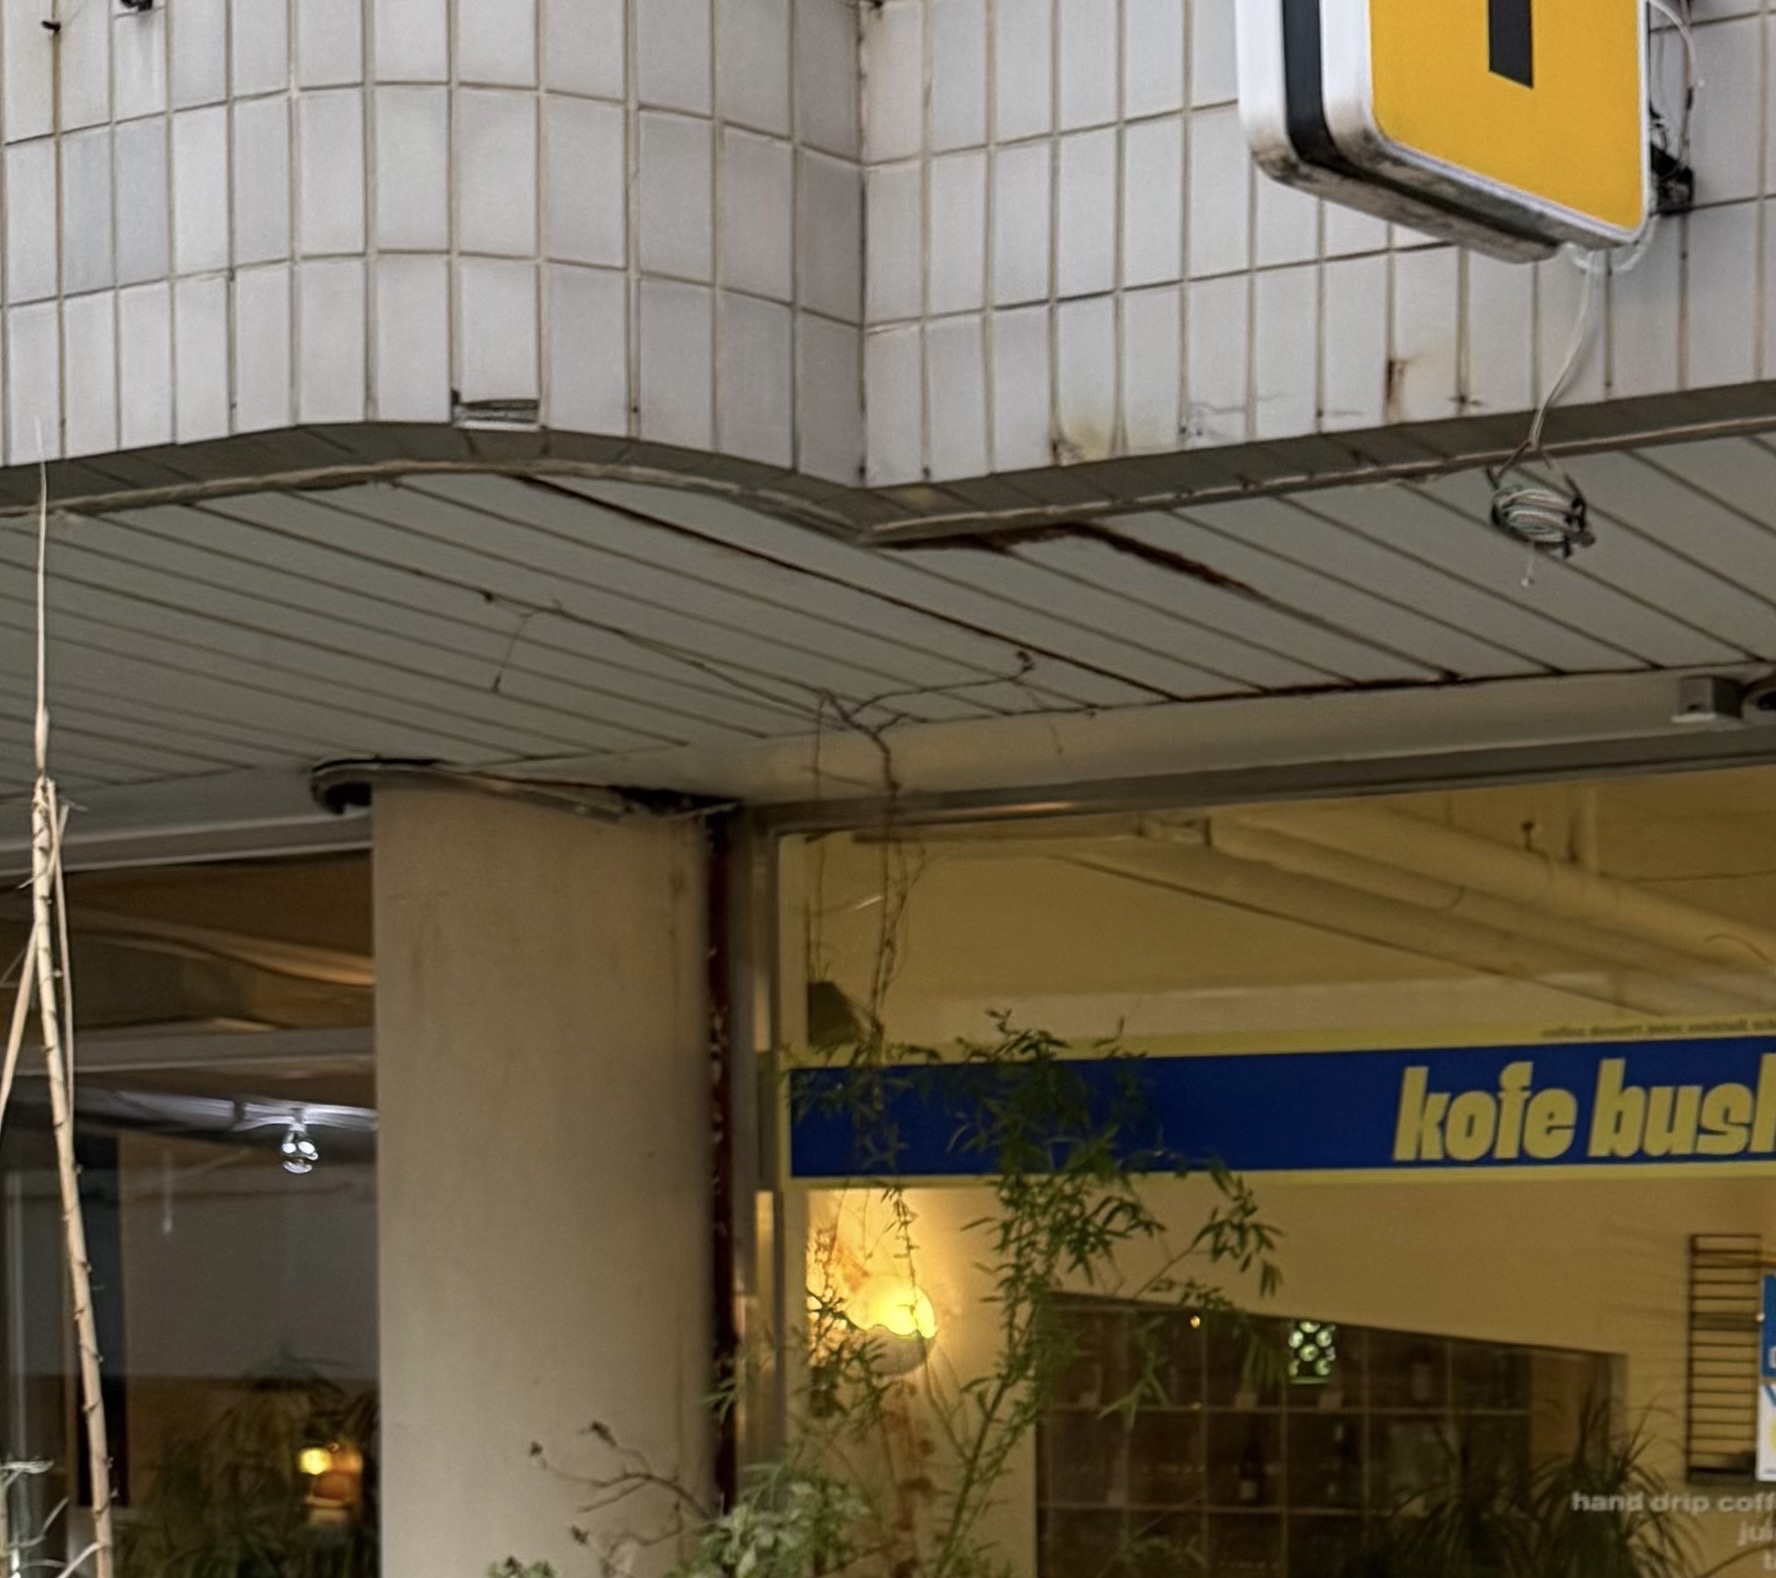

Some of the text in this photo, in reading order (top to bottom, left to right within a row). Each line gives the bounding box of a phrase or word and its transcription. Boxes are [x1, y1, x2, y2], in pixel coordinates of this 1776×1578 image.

[1393, 1061, 1579, 1162] kofe
[1571, 1491, 1644, 1512] hand
[1649, 1492, 1709, 1516] drip
